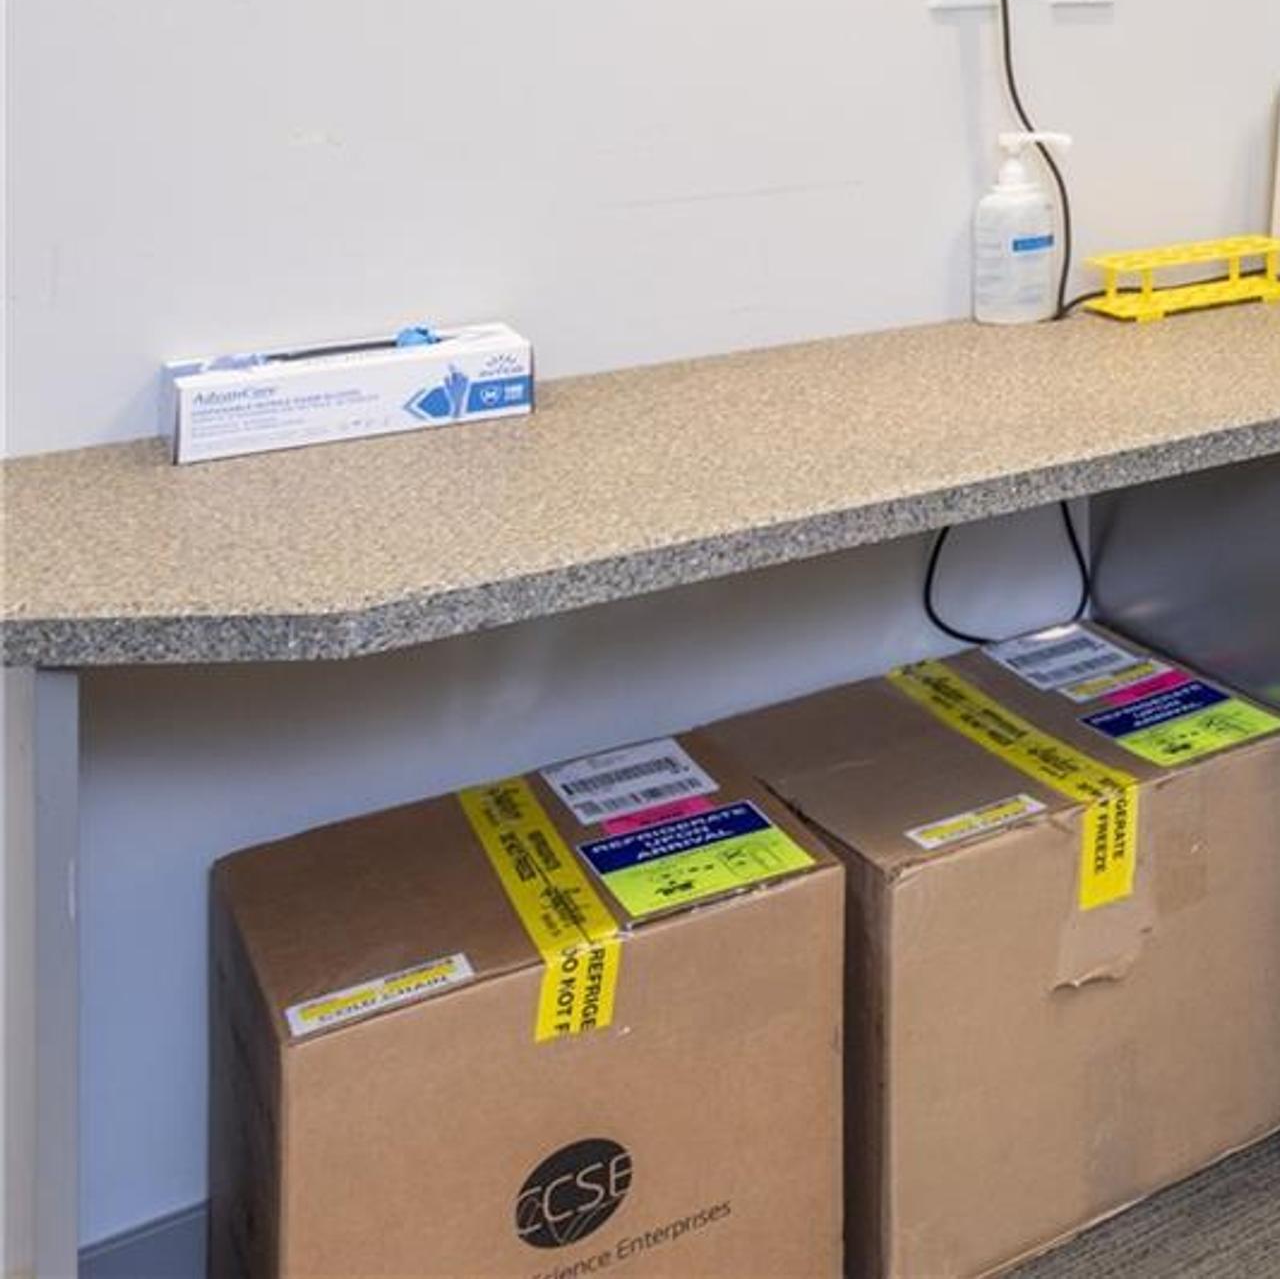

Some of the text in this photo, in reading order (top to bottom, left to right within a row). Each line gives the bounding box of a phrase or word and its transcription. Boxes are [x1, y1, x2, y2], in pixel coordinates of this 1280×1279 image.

[592, 806, 748, 854] REFRIGERATE
[636, 828, 735, 861] ARRIVAL
[644, 824, 710, 848] UPON
[615, 1200, 733, 1260] Enterprises
